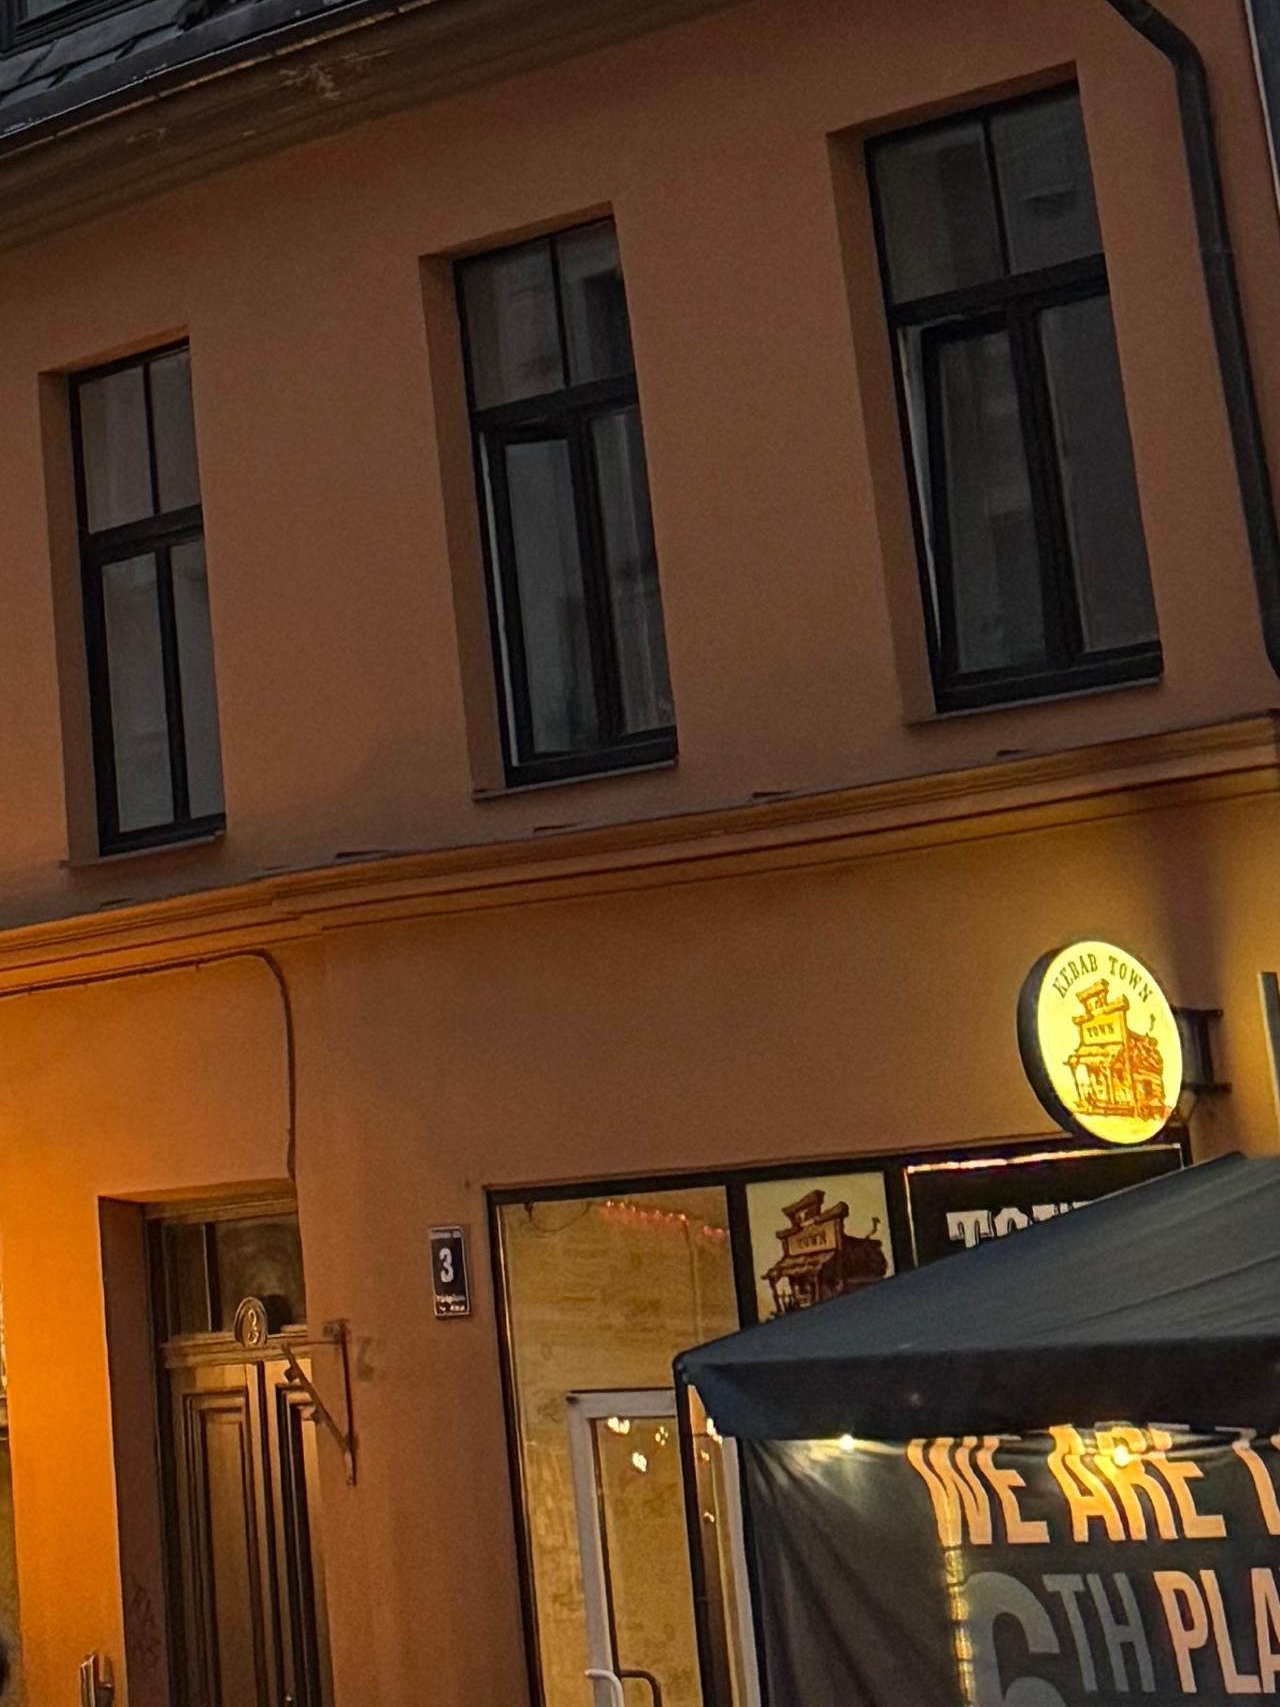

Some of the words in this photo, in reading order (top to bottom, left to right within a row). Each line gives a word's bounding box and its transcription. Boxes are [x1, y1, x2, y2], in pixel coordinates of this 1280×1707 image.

[1052, 953, 1099, 999] KEBAB
[1108, 955, 1154, 1003] TOWN
[1086, 1021, 1115, 1039] TOWN
[947, 1201, 1095, 1249] TO
[439, 1247, 454, 1283] 3
[905, 1435, 1050, 1545] WE
[1047, 1424, 1227, 1542] ARE
